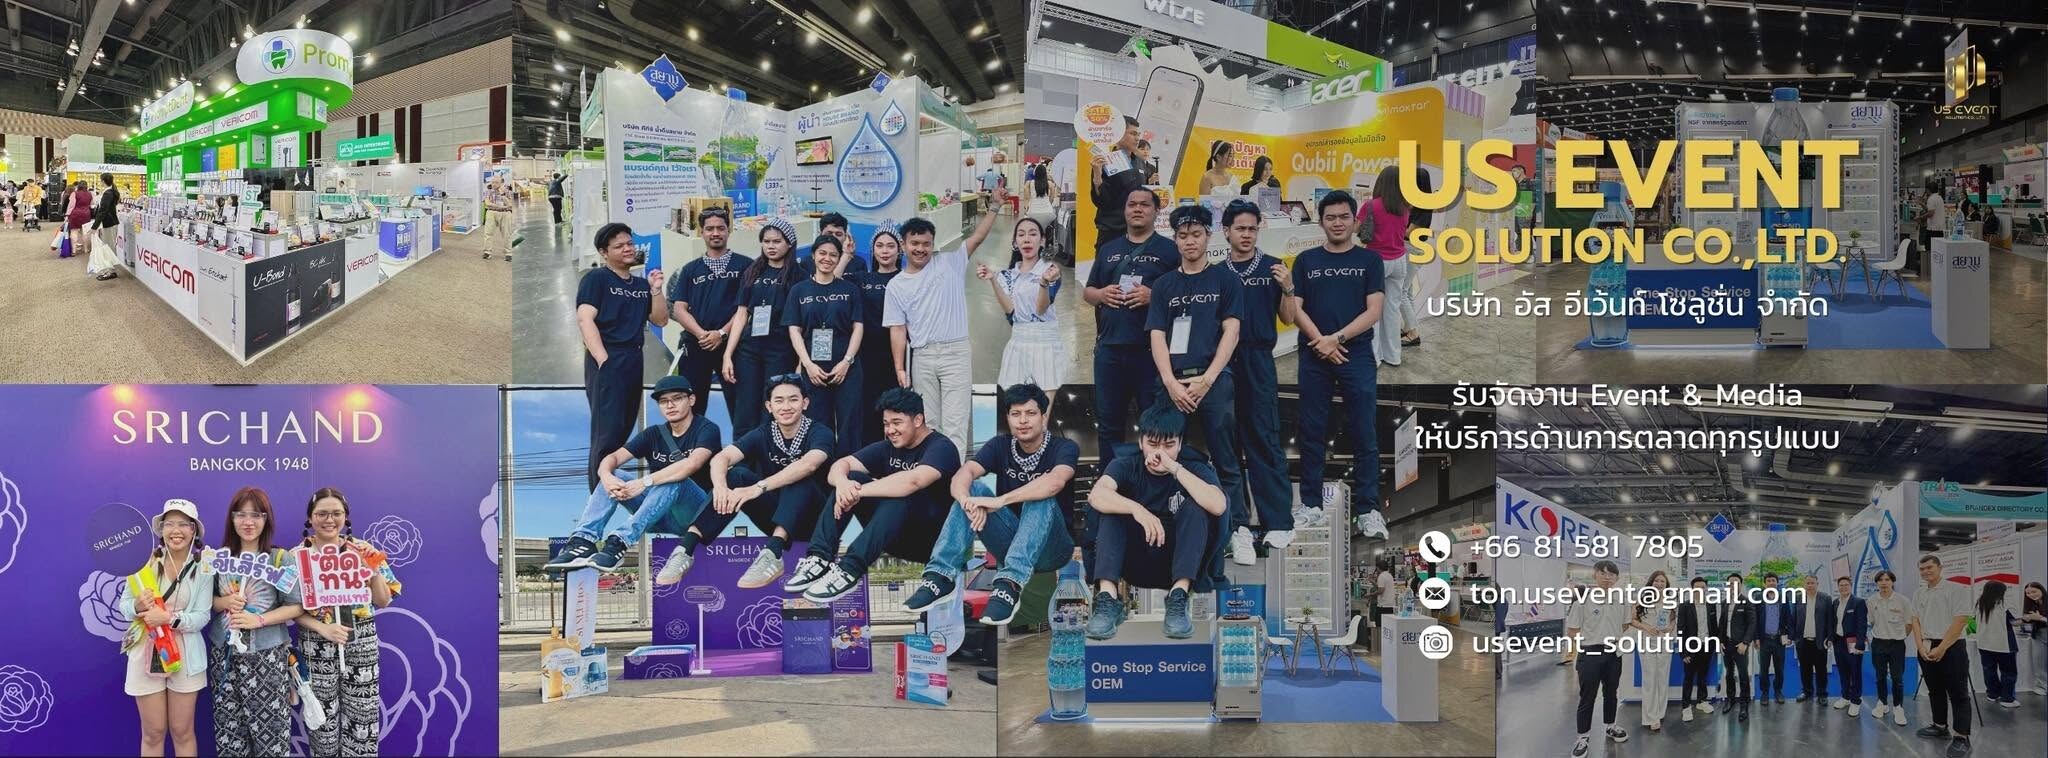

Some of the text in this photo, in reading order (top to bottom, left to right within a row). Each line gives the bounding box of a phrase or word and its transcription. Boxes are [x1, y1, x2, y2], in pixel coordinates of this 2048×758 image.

[303, 42, 353, 80] Prom
[1460, 60, 1519, 88] CITY
[1311, 70, 1372, 104] acer
[220, 110, 259, 128] VERICOM
[798, 112, 820, 134] ผู้นำ
[1291, 151, 1336, 174] Qubii
[136, 243, 195, 294] VERICOM
[1307, 267, 1366, 280] US EVENT
[693, 275, 706, 285] US
[1241, 276, 1272, 286] VENT
[610, 286, 624, 296] US
[799, 293, 850, 305] US EVENT
[112, 409, 383, 445] SRICHAND
[652, 450, 667, 463] US
[889, 456, 902, 469] US
[190, 457, 309, 471] BANGKOK 1948
[1965, 504, 1996, 512] BRANDEX
[1997, 504, 2033, 513] DIRECTORY
[93, 525, 142, 551] SRICHAND
[706, 543, 768, 556] SRICHA
[318, 545, 359, 572] ติด
[318, 572, 362, 590] ทน
[1091, 661, 1207, 675] One Stop Service
[1091, 678, 1123, 690] OEM
